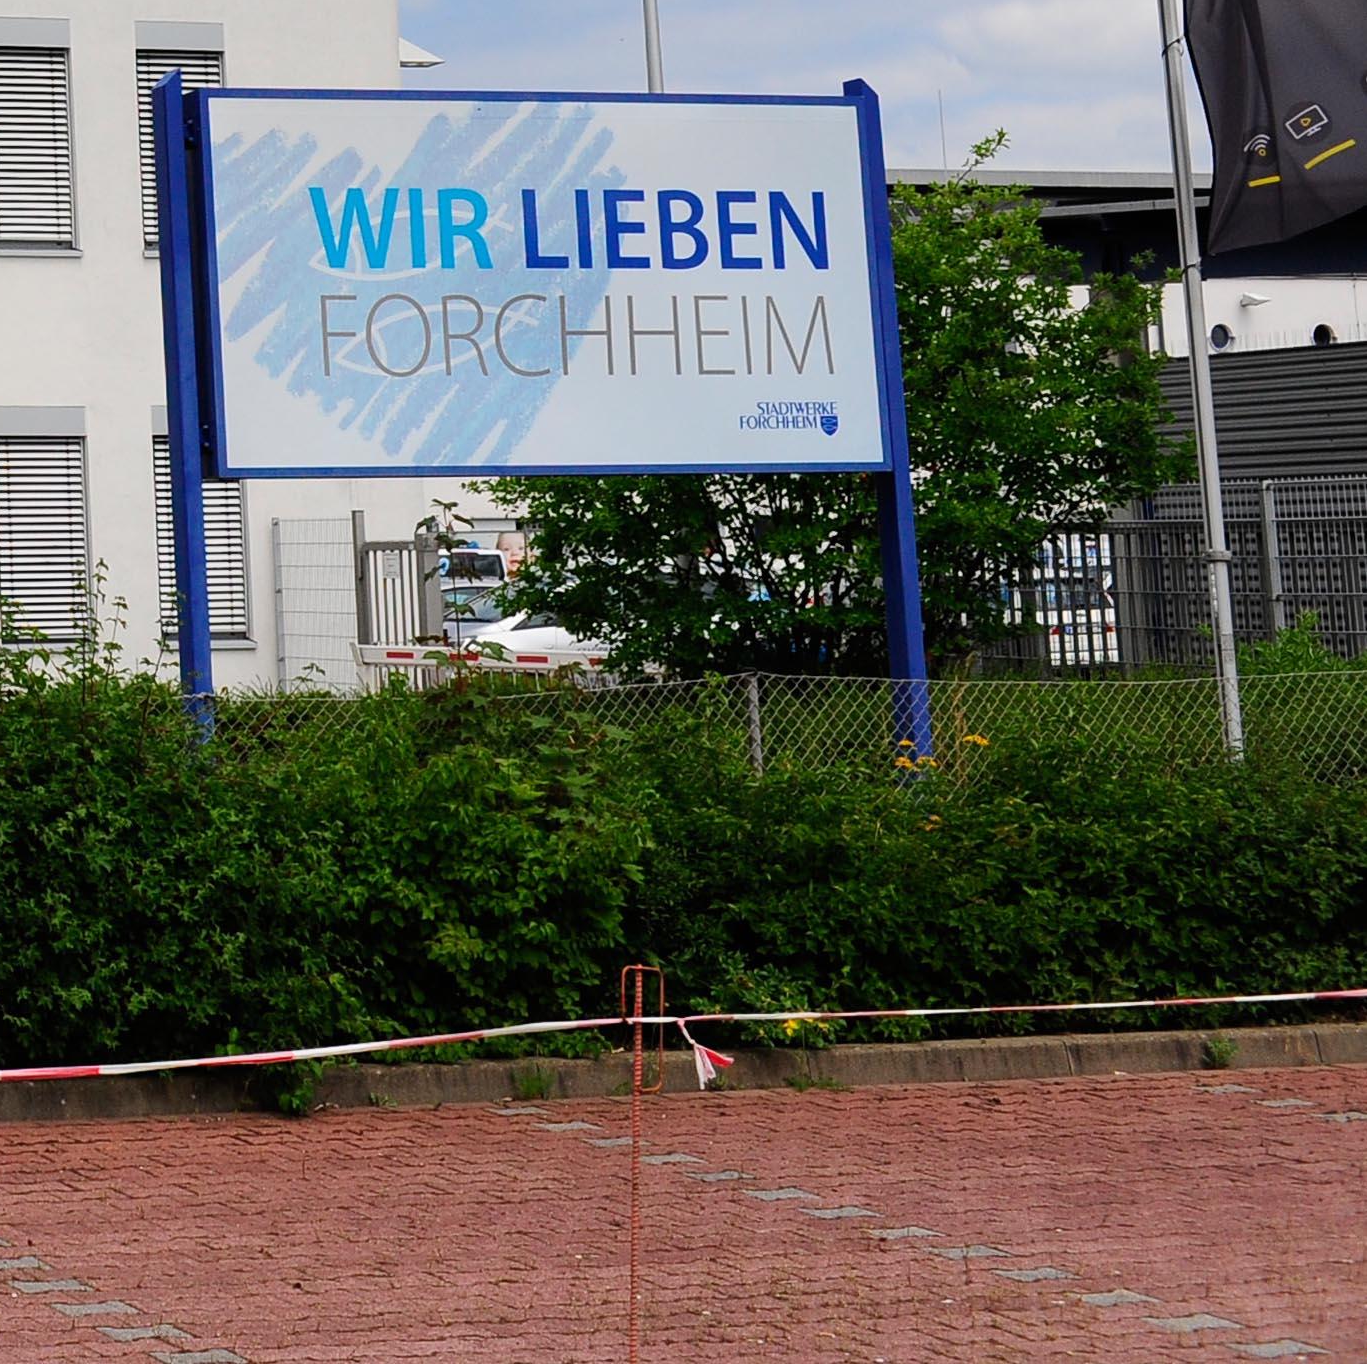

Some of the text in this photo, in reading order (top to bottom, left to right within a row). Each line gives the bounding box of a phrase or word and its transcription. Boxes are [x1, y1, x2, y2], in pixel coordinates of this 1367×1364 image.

[308, 187, 830, 271] WIR LIEBEN
[319, 293, 837, 377] FORCHHEIM
[739, 415, 818, 429] FORCHHEIM
[756, 401, 838, 415] STADTWERKE
